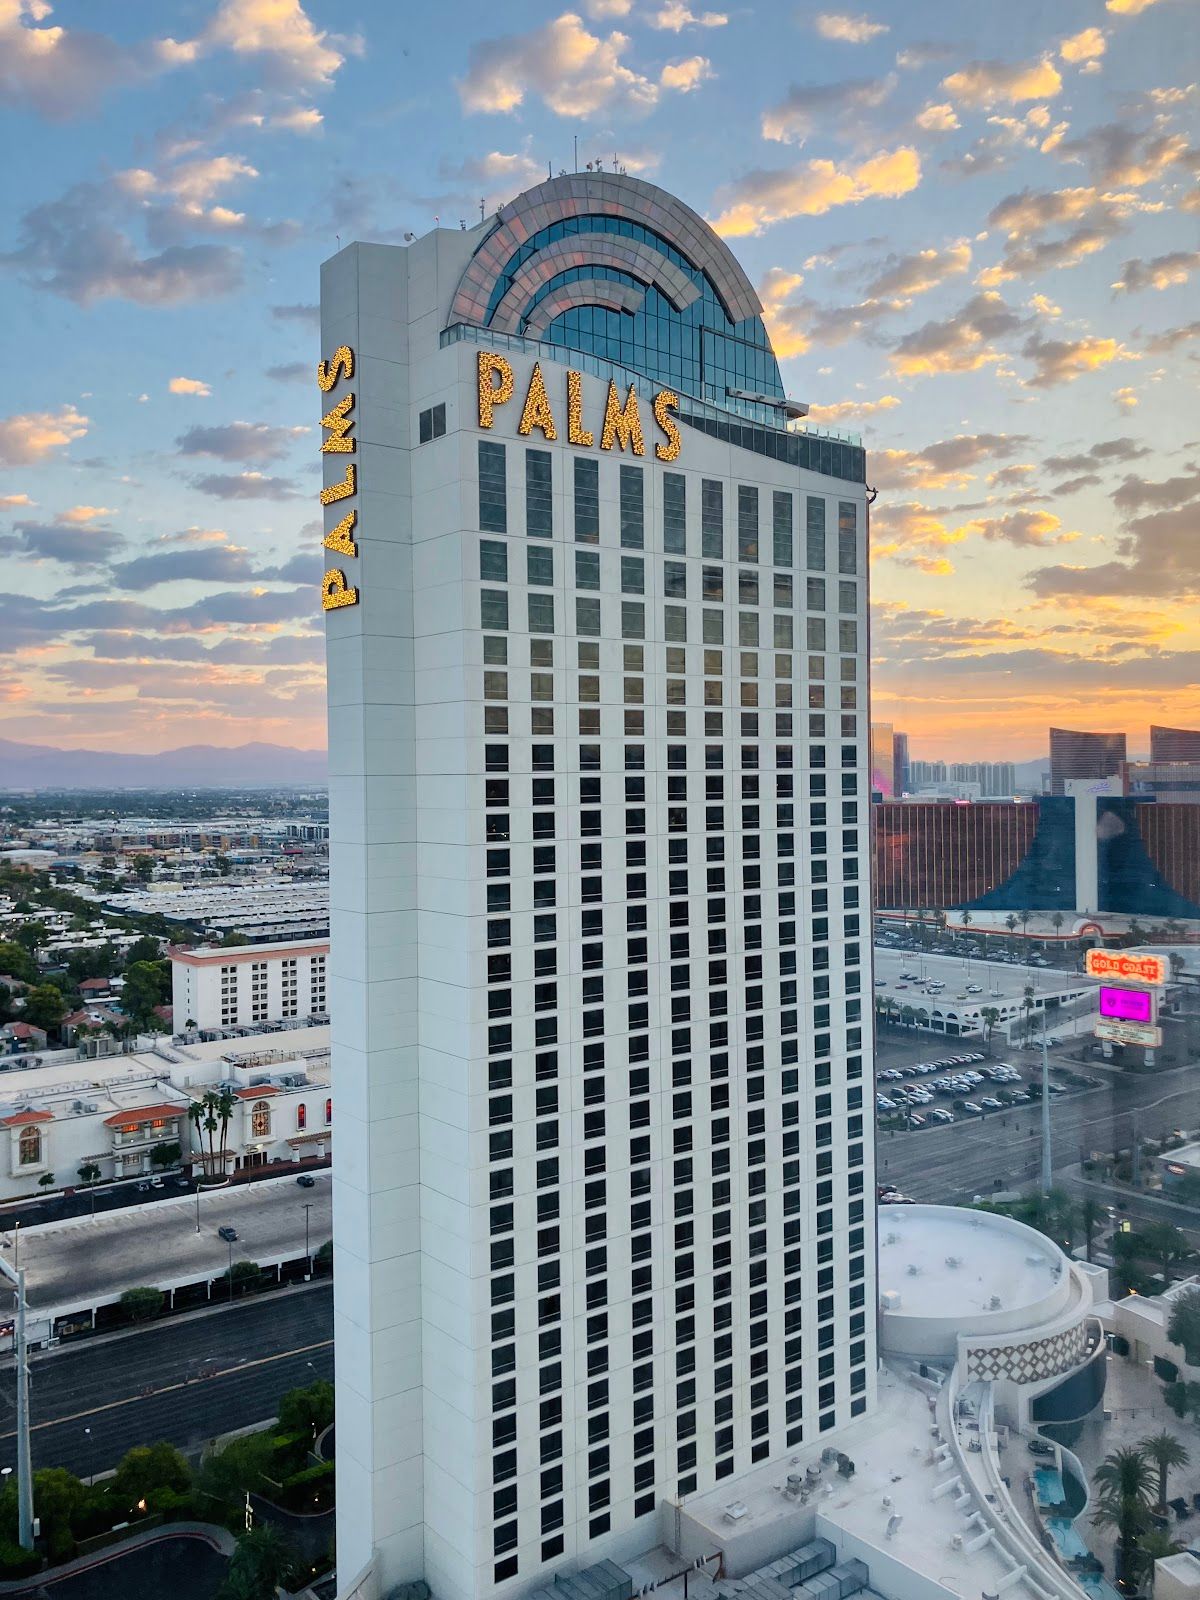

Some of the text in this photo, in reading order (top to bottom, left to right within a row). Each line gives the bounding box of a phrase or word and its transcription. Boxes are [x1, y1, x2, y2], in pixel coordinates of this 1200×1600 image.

[478, 350, 682, 462] PALMS
[318, 345, 358, 610] PALMS
[1092, 959, 1156, 975] GOLD COAST
